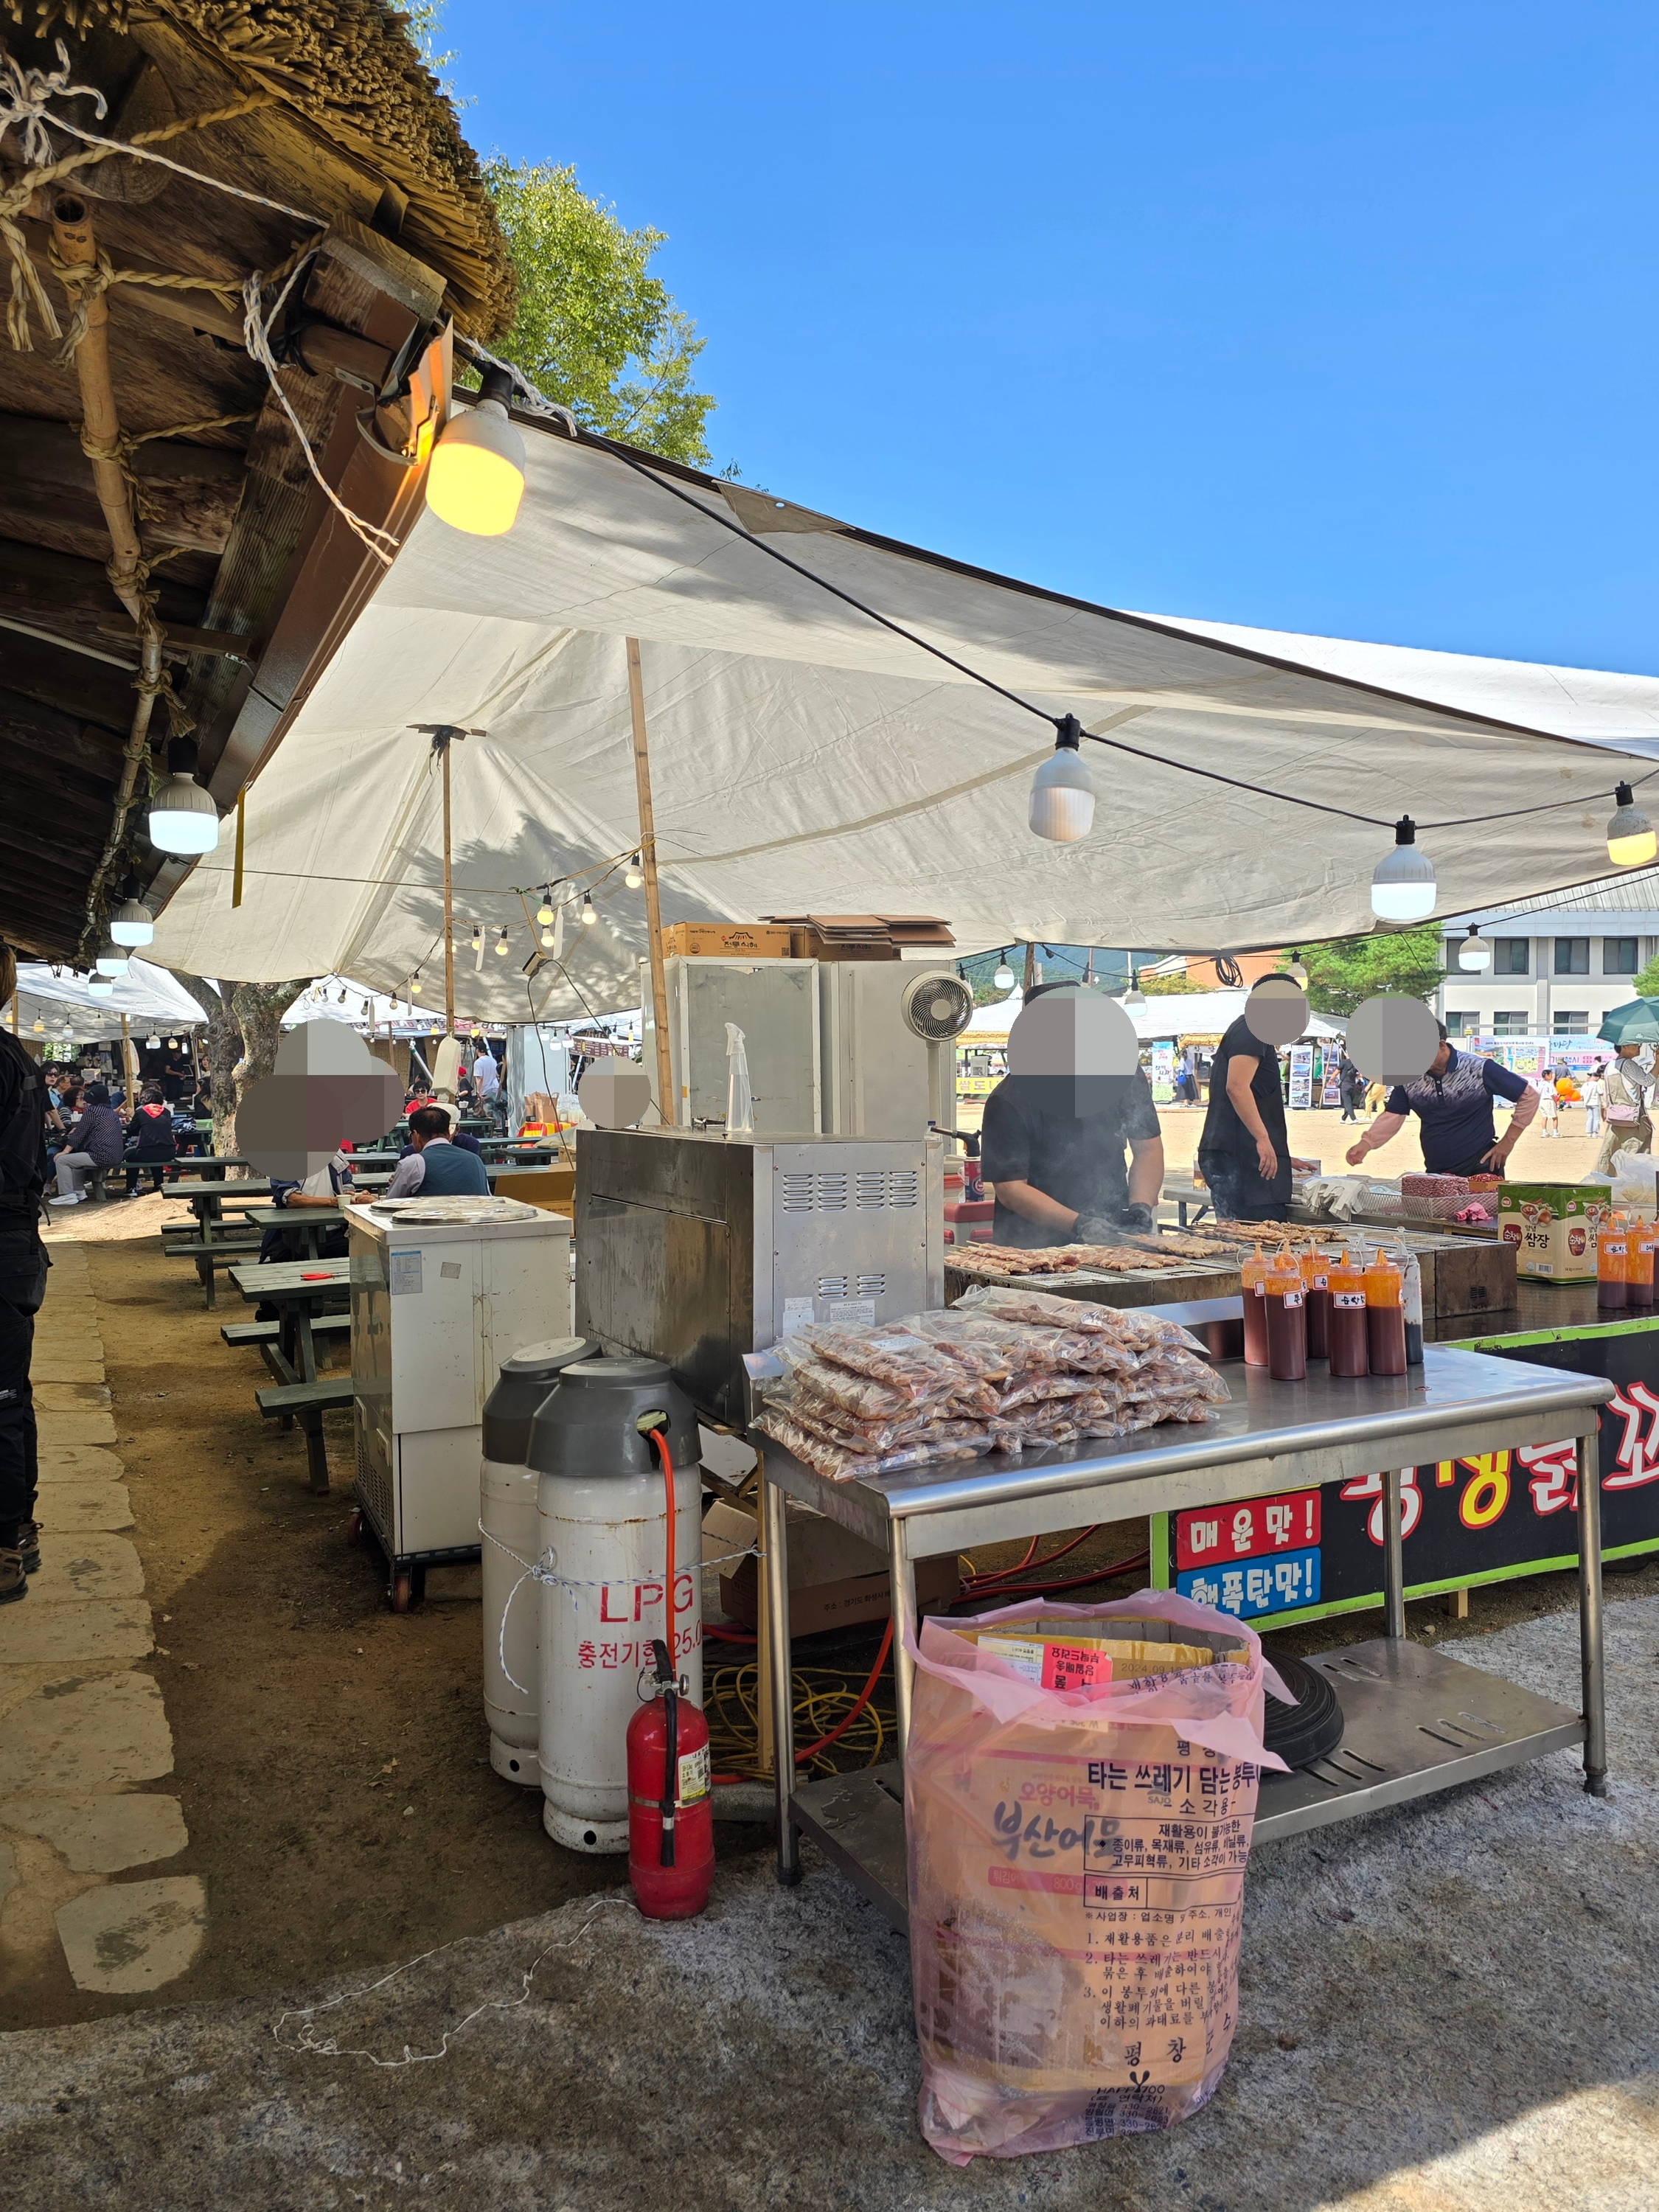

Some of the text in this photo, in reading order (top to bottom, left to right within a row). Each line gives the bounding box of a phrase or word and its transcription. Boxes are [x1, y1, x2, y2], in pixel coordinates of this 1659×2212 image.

[1524, 1232, 1550, 1248] 쌈장
[1190, 1500, 1313, 1554] 매운맛!
[1190, 1558, 1312, 1615] 핵폭탄맛!
[600, 1574, 693, 1622] LPG
[844, 1596, 863, 1607] 경기도
[864, 1592, 883, 1603] 화성시
[1051, 1647, 1100, 1663] 부탁드려요
[1056, 1660, 1094, 1676] 당일배송
[1088, 1761, 1128, 1790] 타는
[1134, 1764, 1190, 1793] 쓰레기
[1200, 1766, 1231, 1795] 담는
[1018, 1782, 1096, 1809] 오양어묵
[990, 1800, 1124, 1869] 부산어묵
[1158, 1819, 1240, 1840] 재활용이 불가능한
[1112, 1838, 1148, 1853] 종이류,
[1152, 1838, 1189, 1855] 목재류,
[1194, 1841, 1220, 1855] 섬유류,
[1112, 1854, 1172, 1870] 고무피혁류,
[1178, 1856, 1200, 1871] 기타
[1203, 1854, 1225, 1868] 소각이
[1095, 1885, 1139, 1901] 배출처
[1096, 1911, 1128, 1922] 사업장
[1141, 1912, 1175, 1924] 업소명
[1188, 1909, 1211, 1919] 주소,
[1214, 1907, 1231, 1918] 개인
[1088, 1933, 1099, 1944] 1.
[1104, 1931, 1172, 1947] 재활용품은
[1085, 1947, 1221, 1967] 2. 타는 쓰레기는 반드시
[1134, 1966, 1147, 1981] 후
[1154, 1962, 1211, 1980] 배출하여야
[1083, 1986, 1096, 1998] 3.
[1102, 1985, 1113, 1999] 이
[1175, 1981, 1200, 1996] 다른
[1102, 1996, 1204, 2015] 생활폐기물을 버릴
[1099, 2014, 1140, 2031] 이하의
[1145, 2011, 1194, 2028] 과태료를
[1085, 2127, 1115, 2140] 진부면
